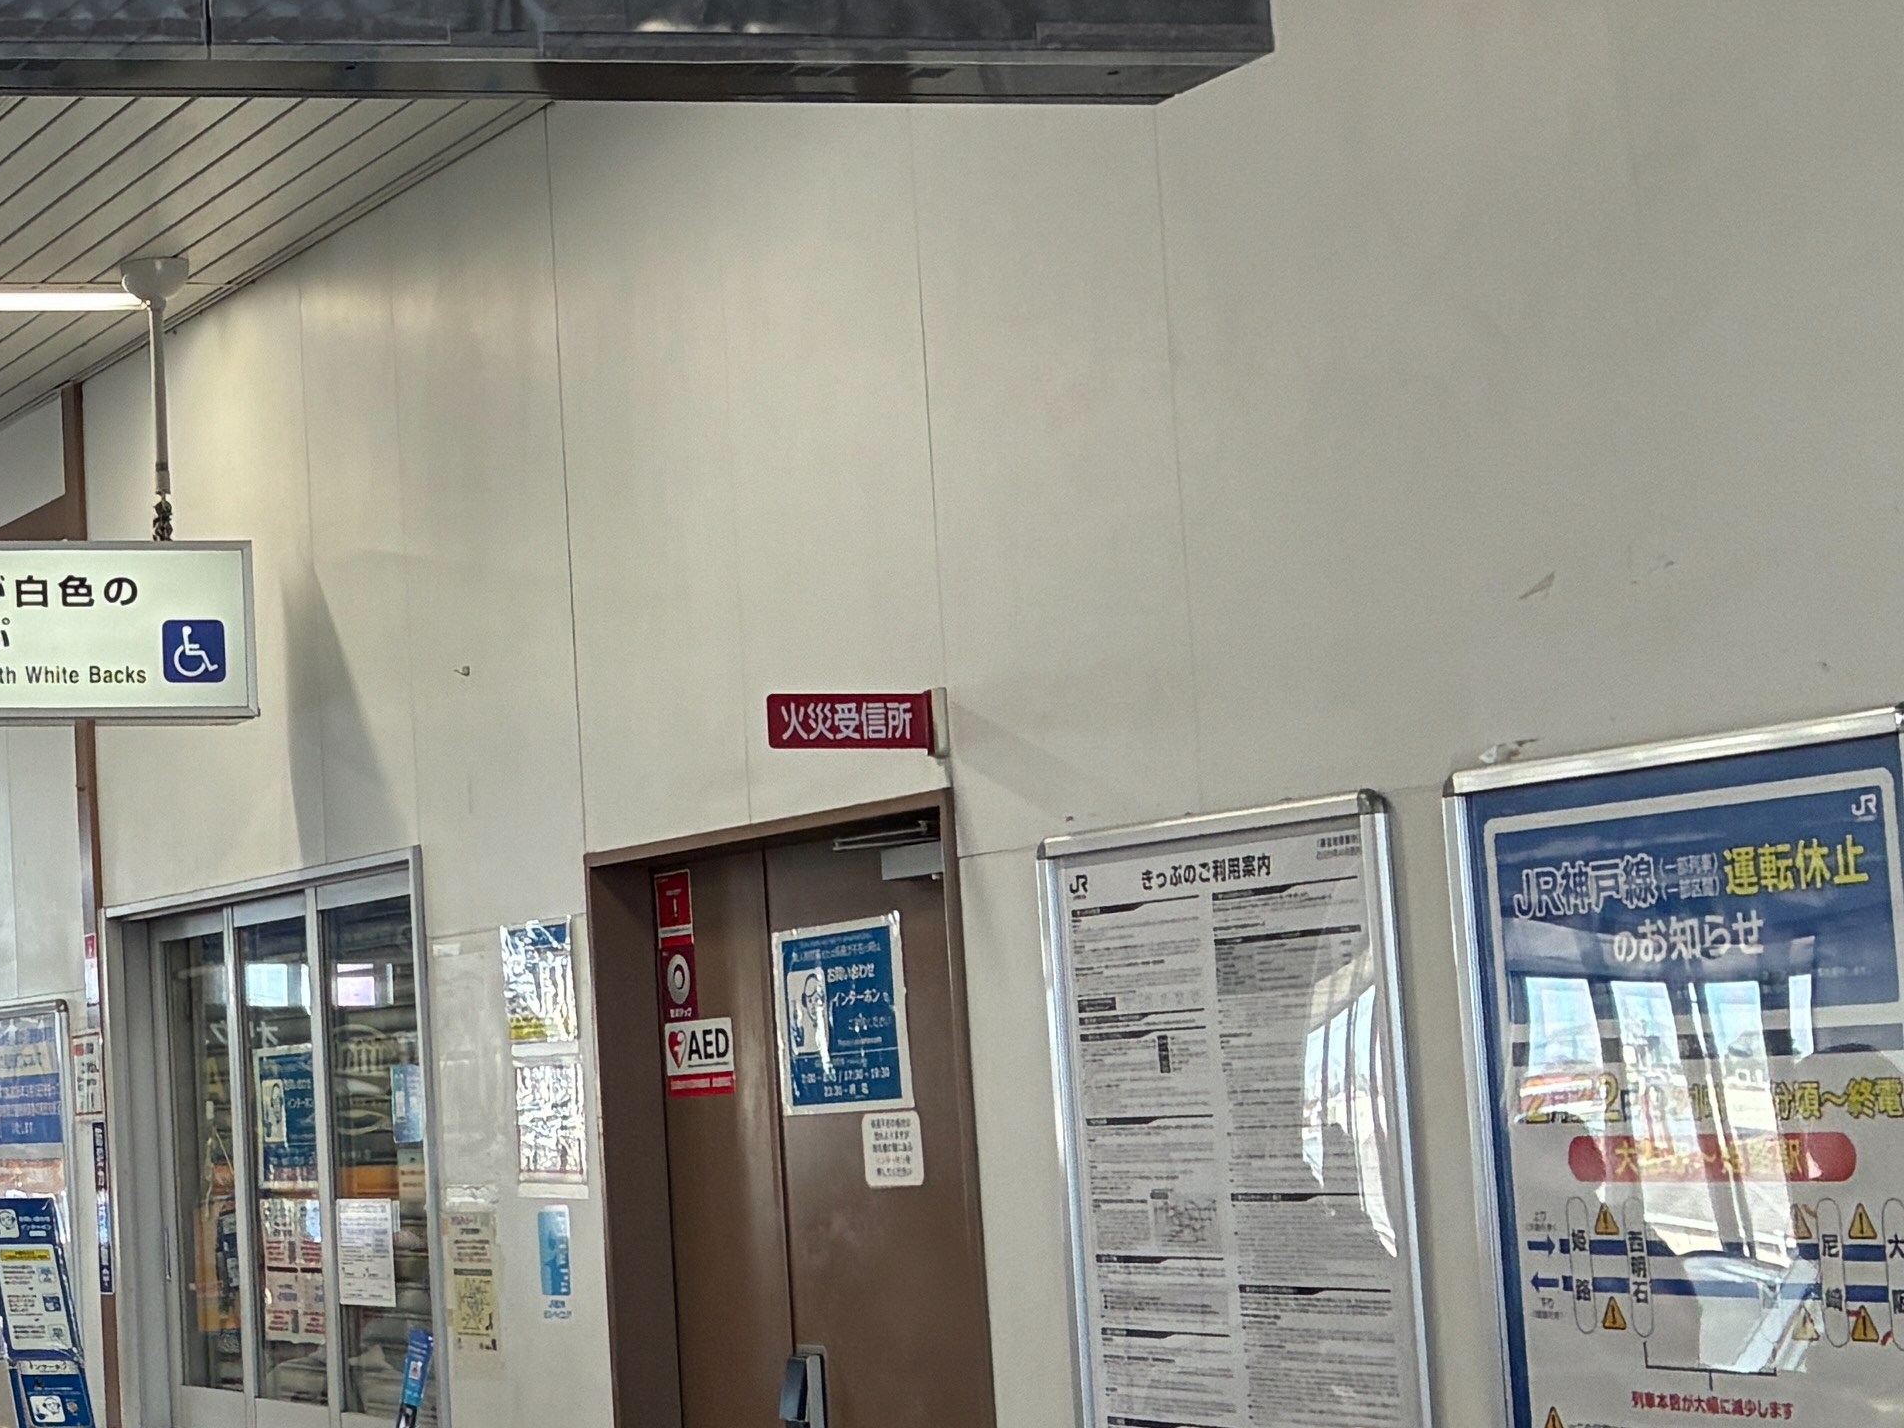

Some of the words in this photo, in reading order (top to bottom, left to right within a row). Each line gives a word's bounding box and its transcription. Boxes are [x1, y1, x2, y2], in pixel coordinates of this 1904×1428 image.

[26, 666, 79, 683] White
[89, 666, 146, 683] Backs
[781, 702, 912, 740] 火災受信所
[1851, 793, 1876, 816] JR
[1723, 834, 1868, 896] 運転休止
[1069, 875, 1087, 894] JR
[1613, 910, 1764, 963] のお知らせ
[688, 1028, 729, 1061] AED
